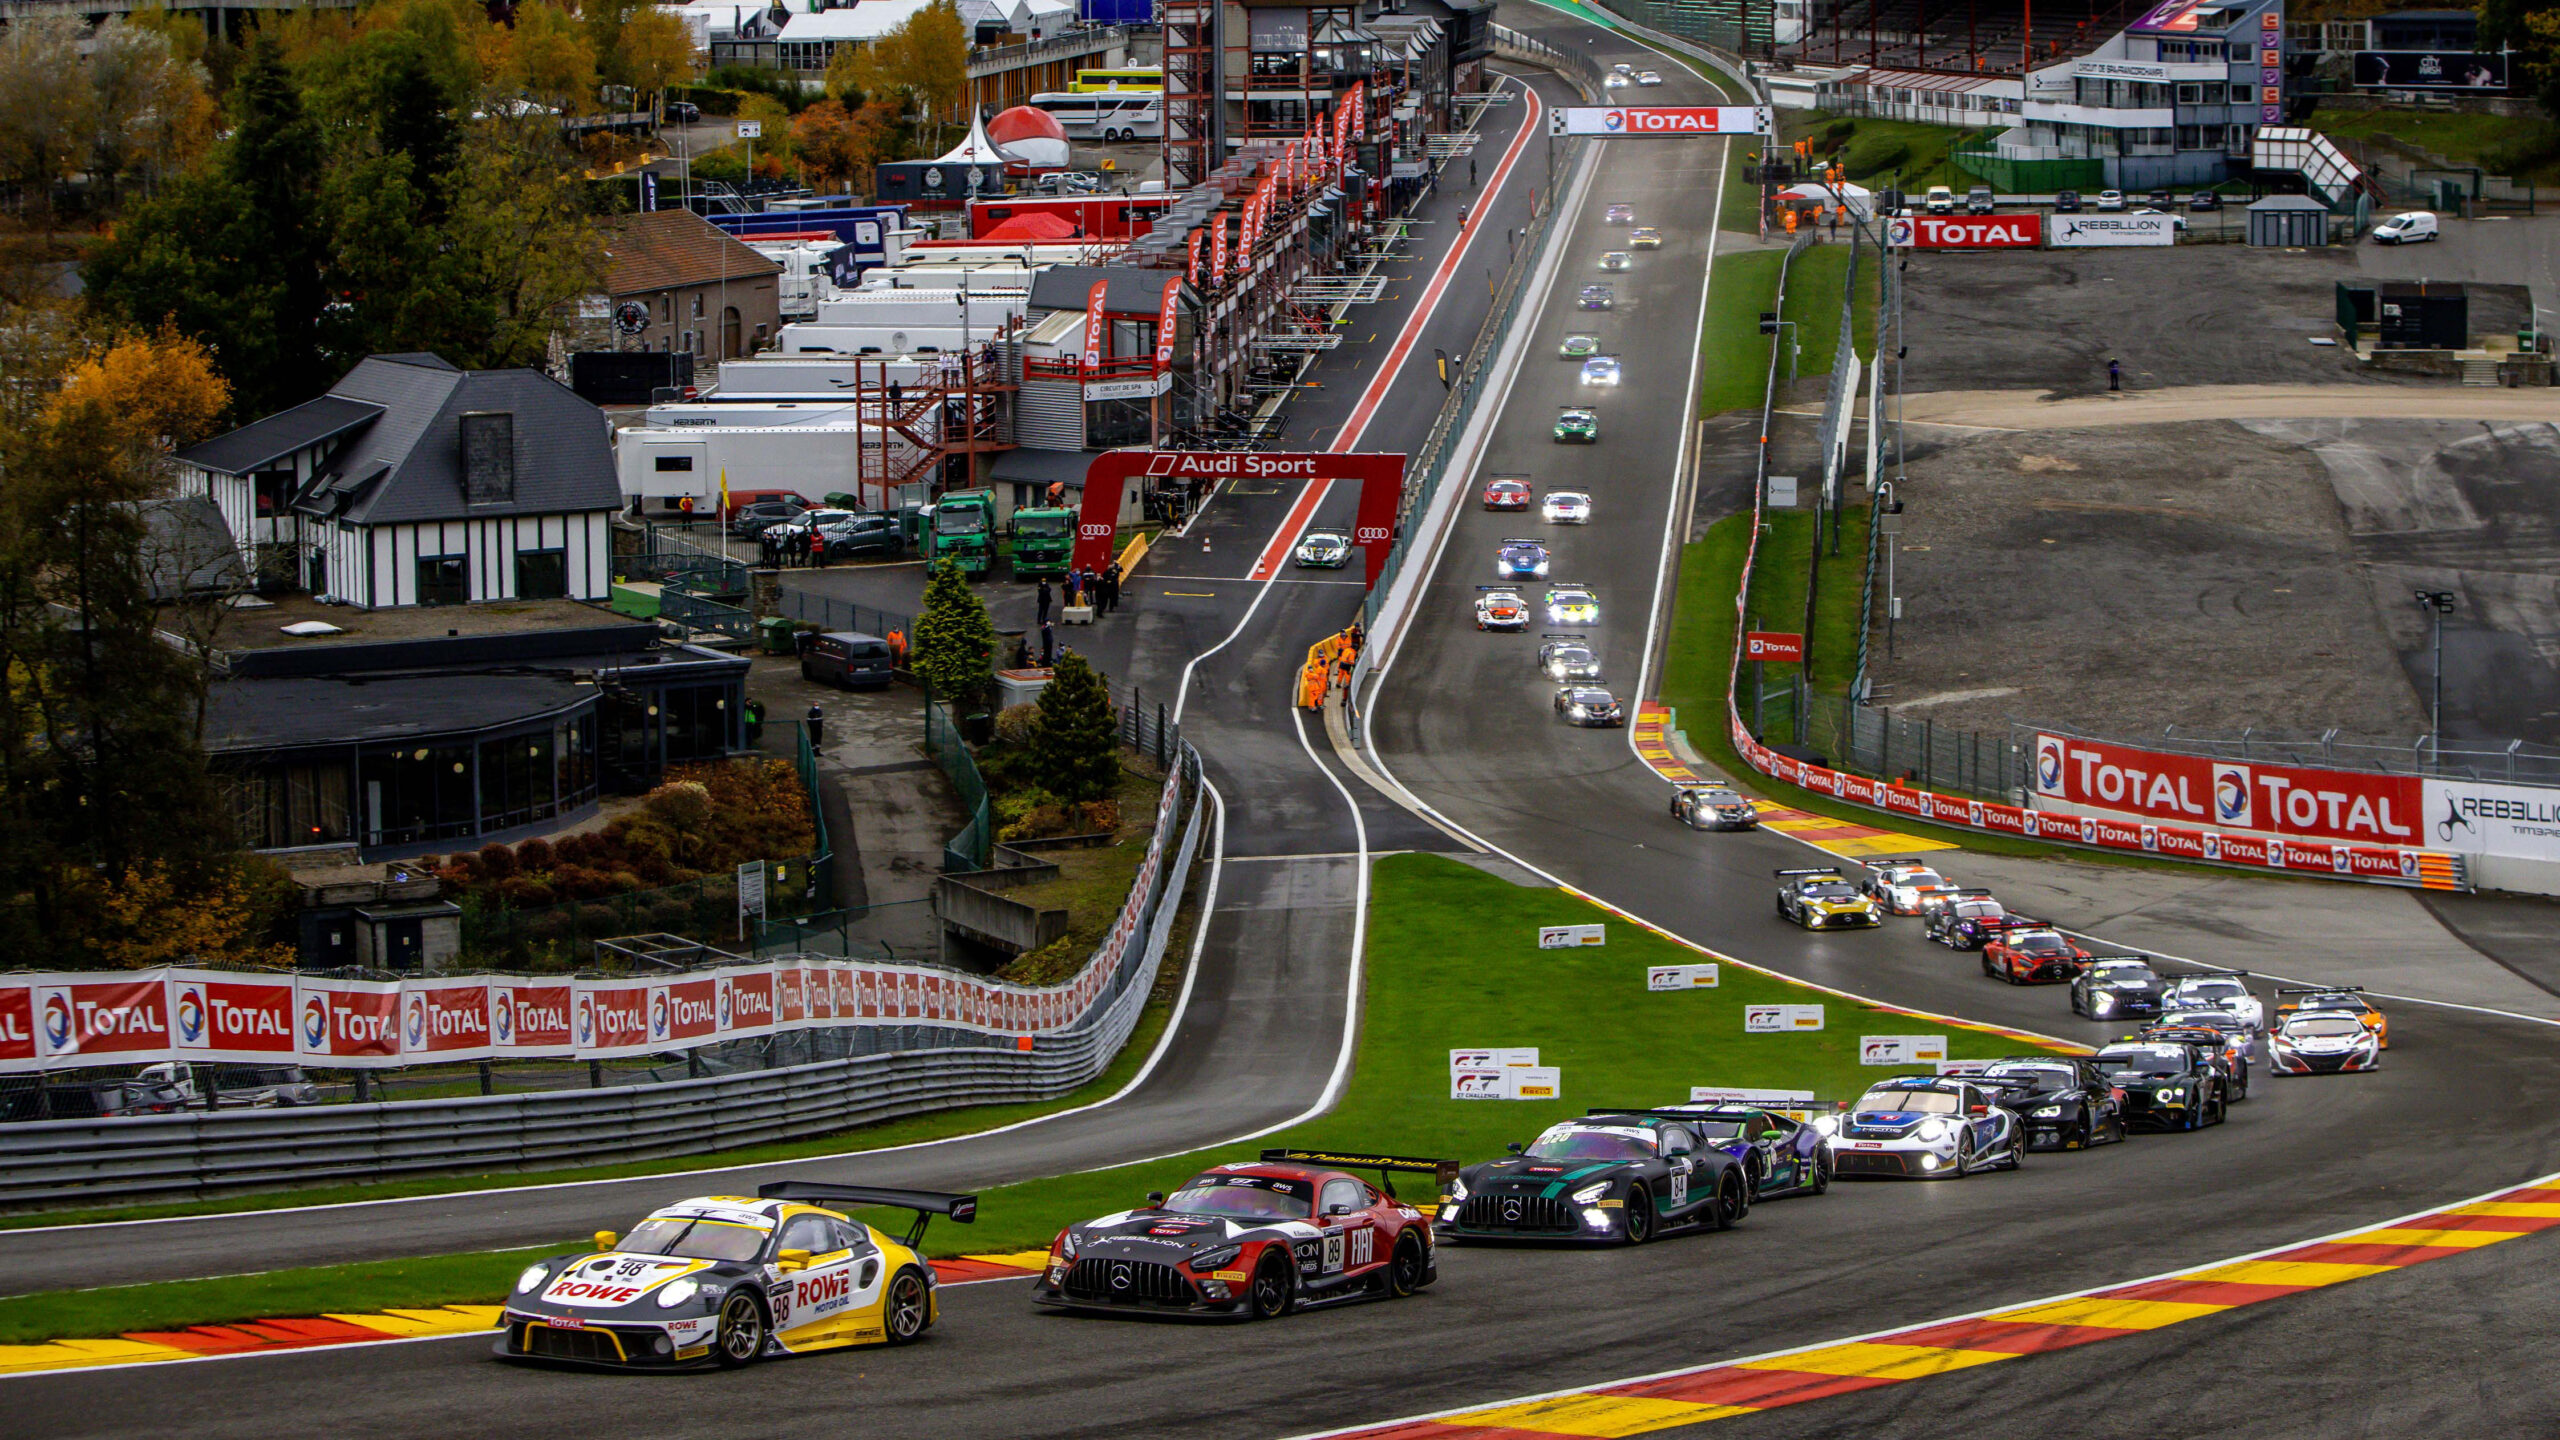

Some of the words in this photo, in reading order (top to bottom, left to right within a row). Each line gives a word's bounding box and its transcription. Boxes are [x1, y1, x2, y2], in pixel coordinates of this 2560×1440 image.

[1353, 84, 1363, 127] TOTAL
[1630, 111, 1716, 130] TOTAL
[1336, 110, 1346, 154] TOTAL
[1240, 200, 1257, 255] TOTAL
[1920, 220, 2032, 242] TOTAL
[1214, 218, 1226, 274] TOTAL
[1190, 235, 1203, 281] OTAL
[1087, 286, 1106, 348] TOTAL
[1160, 283, 1180, 343] TOTAL
[1100, 384, 1121, 392] CIRCUIT
[673, 418, 716, 426] HERBERTH
[861, 441, 904, 449] HERBRTH
[1180, 454, 1238, 474] Audi
[1245, 455, 1316, 477] Sport
[1764, 642, 1799, 653] TOTAL
[1778, 759, 1799, 779] TOTAL
[1807, 771, 1834, 789] TOTAL
[1845, 780, 1873, 799] TOTAL
[2070, 749, 2204, 816] TOTAL
[1887, 790, 1920, 809] TOTAL
[1933, 799, 1969, 819] TOTAL
[2258, 774, 2411, 838] TOTAL
[2462, 797, 2560, 823] REBELLI
[1984, 809, 2023, 828] TOTAL
[2038, 817, 2081, 836] TOTAL
[2097, 825, 2140, 844] TOTAL
[2160, 833, 2203, 852] TOTAL
[2221, 840, 2267, 859] TOTAL
[2286, 847, 2332, 866] TOTAL
[2351, 852, 2400, 870] TOTAL
[734, 988, 772, 1016] TOTAL
[781, 982, 803, 1008] TOTAL
[811, 981, 830, 1007] TOTAL
[76, 1001, 166, 1037] TOTAL
[209, 999, 291, 1036] TOTAL
[429, 1004, 487, 1036] TOTAL
[516, 1001, 569, 1032] TOTAL
[596, 1004, 646, 1034] TOTAL
[671, 997, 715, 1027] TOTAL
[333, 1006, 398, 1041] TOTAL
[1522, 1086, 1551, 1095] PIRELLI
[1272, 1182, 1294, 1191] aws
[1674, 1175, 1685, 1198] 84
[1599, 1200, 1623, 1208] PIRELLI
[738, 1212, 760, 1222] aws
[1110, 1235, 1187, 1249] REBELLION
[1328, 1238, 1341, 1263] 89
[1352, 1226, 1375, 1266] FIAT
[616, 1262, 647, 1277] 98
[1216, 1271, 1244, 1280] PIRELLI
[548, 1281, 642, 1303] ROWE
[796, 1268, 850, 1309] ROWE
[773, 1295, 790, 1324] 98
[814, 1300, 839, 1315] MOTOR
[839, 1295, 850, 1306] OIL
[549, 1317, 584, 1330] TOTAL
[667, 1320, 698, 1331] ROWE
